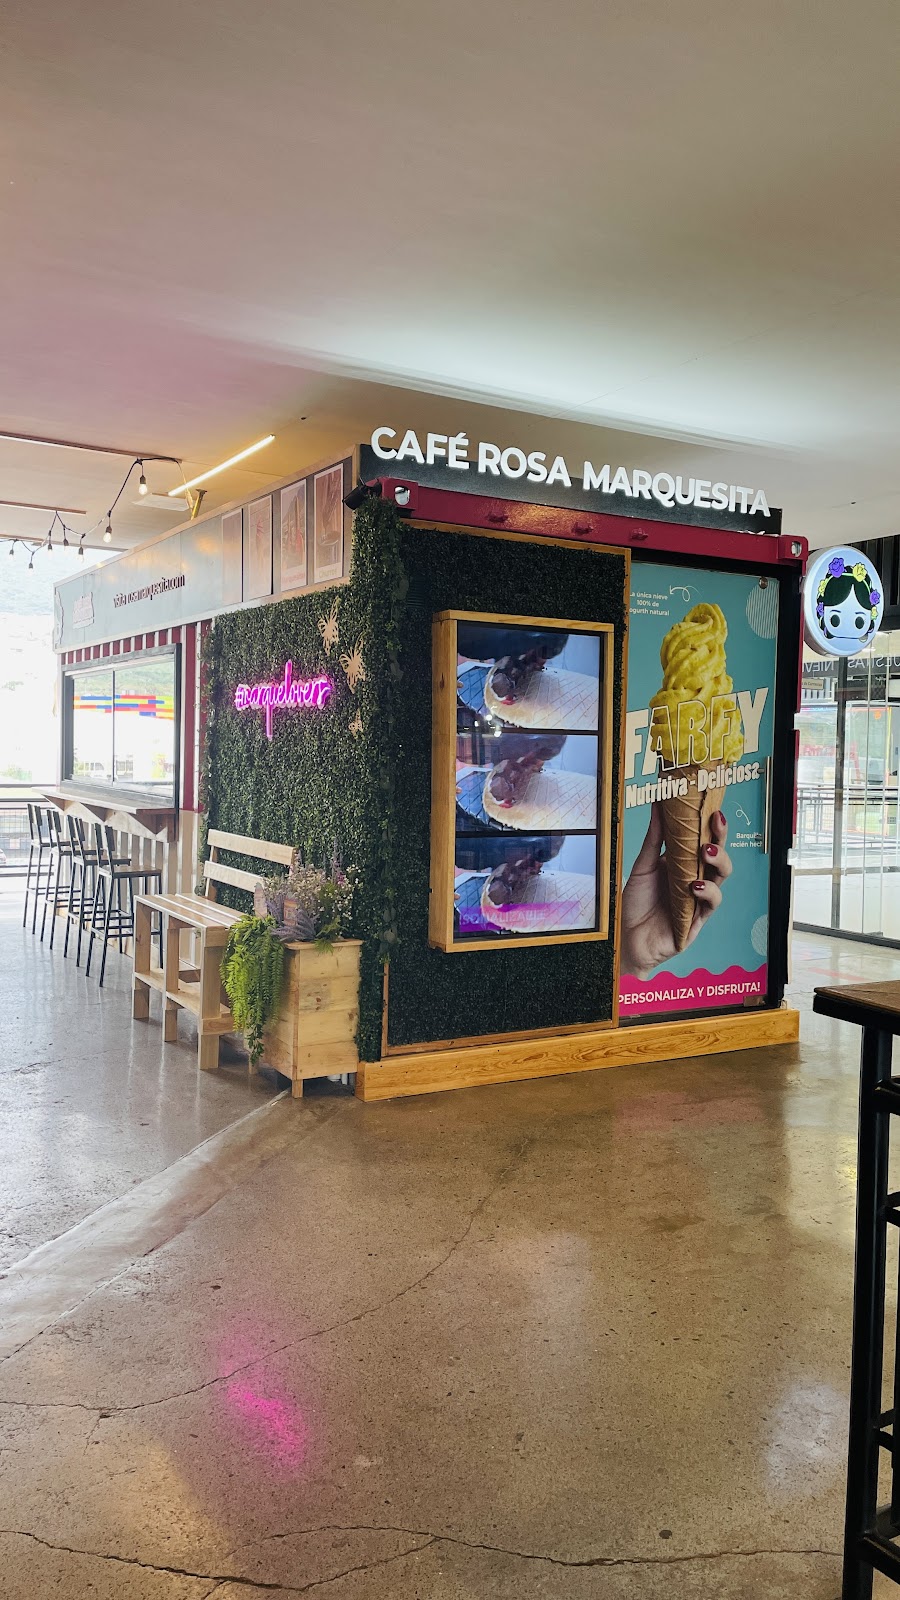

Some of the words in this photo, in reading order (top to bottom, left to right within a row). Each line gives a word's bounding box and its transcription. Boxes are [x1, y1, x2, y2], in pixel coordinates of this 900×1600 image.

[370, 426, 470, 469] CAFÉ
[477, 442, 572, 487] ROSA
[582, 460, 771, 517] MARQUESITA
[624, 687, 769, 780] FARFY
[625, 775, 688, 808] Nutritiva
[697, 761, 760, 793] Deliciosa
[696, 987, 705, 997] Y
[706, 982, 761, 998] DISFRUTA!
